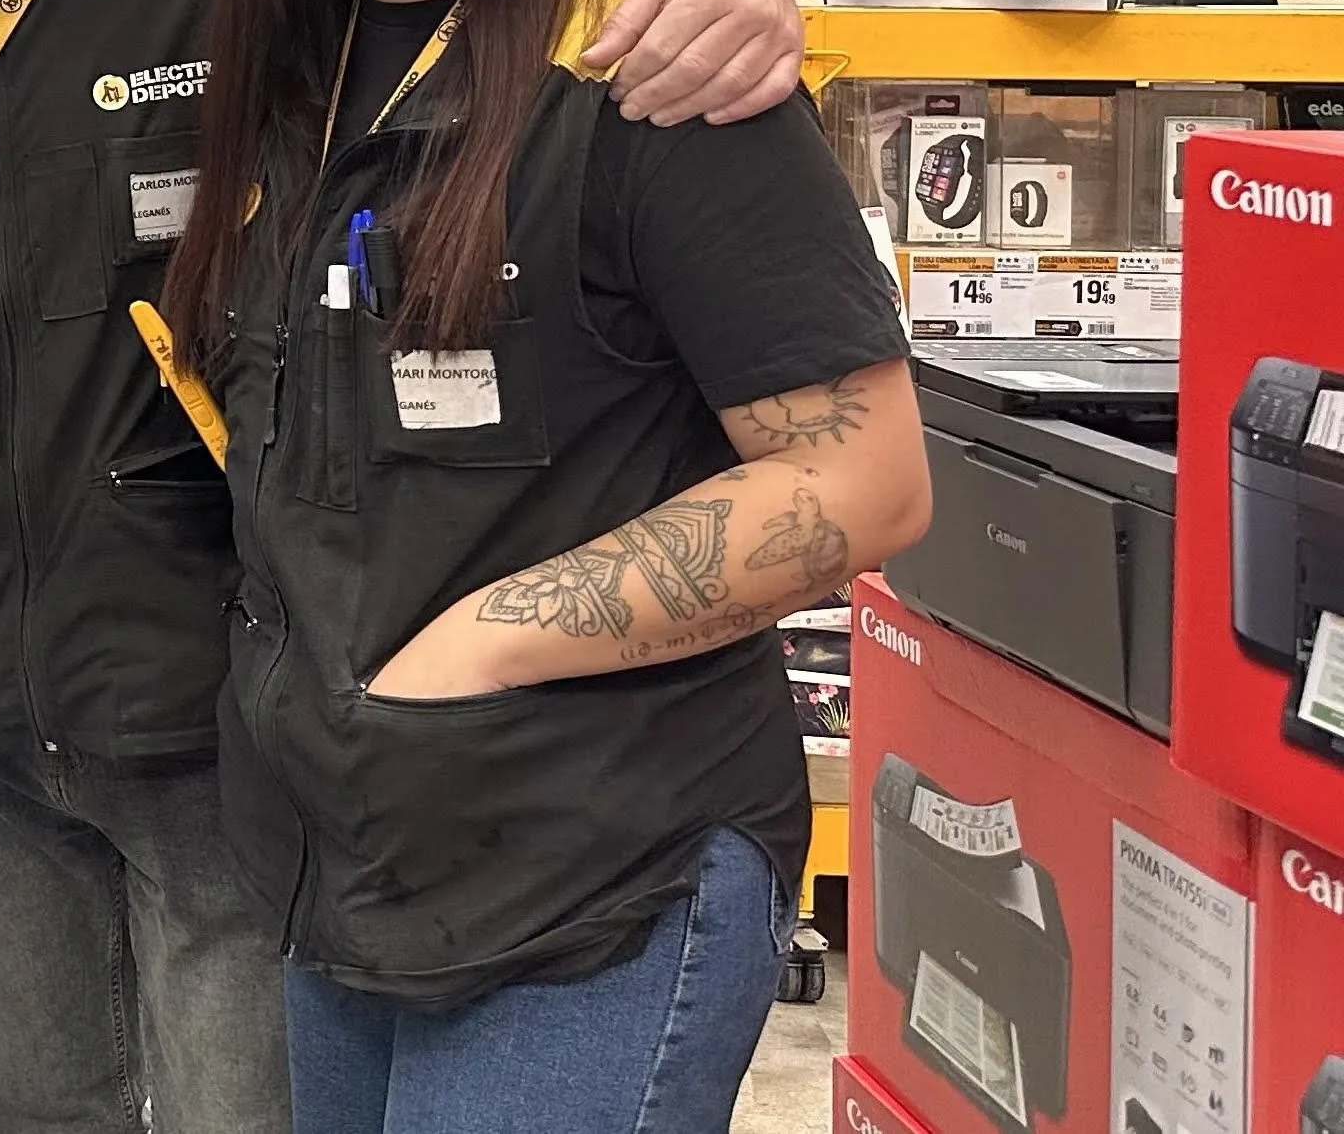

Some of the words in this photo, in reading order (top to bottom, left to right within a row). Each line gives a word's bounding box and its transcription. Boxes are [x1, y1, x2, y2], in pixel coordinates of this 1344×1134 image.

[129, 59, 213, 88] ELECTR
[131, 78, 208, 104] DEPOT
[131, 178, 172, 191] CARLOS
[1210, 169, 1332, 227] Canon
[948, 279, 979, 304] 14
[978, 292, 993, 304] 96
[1072, 279, 1102, 304] 19
[1101, 292, 1116, 305] 49
[399, 399, 437, 411] GANÉS
[986, 522, 1028, 554] Canon
[860, 606, 922, 667] Canon
[1120, 839, 1161, 883] PIXMA
